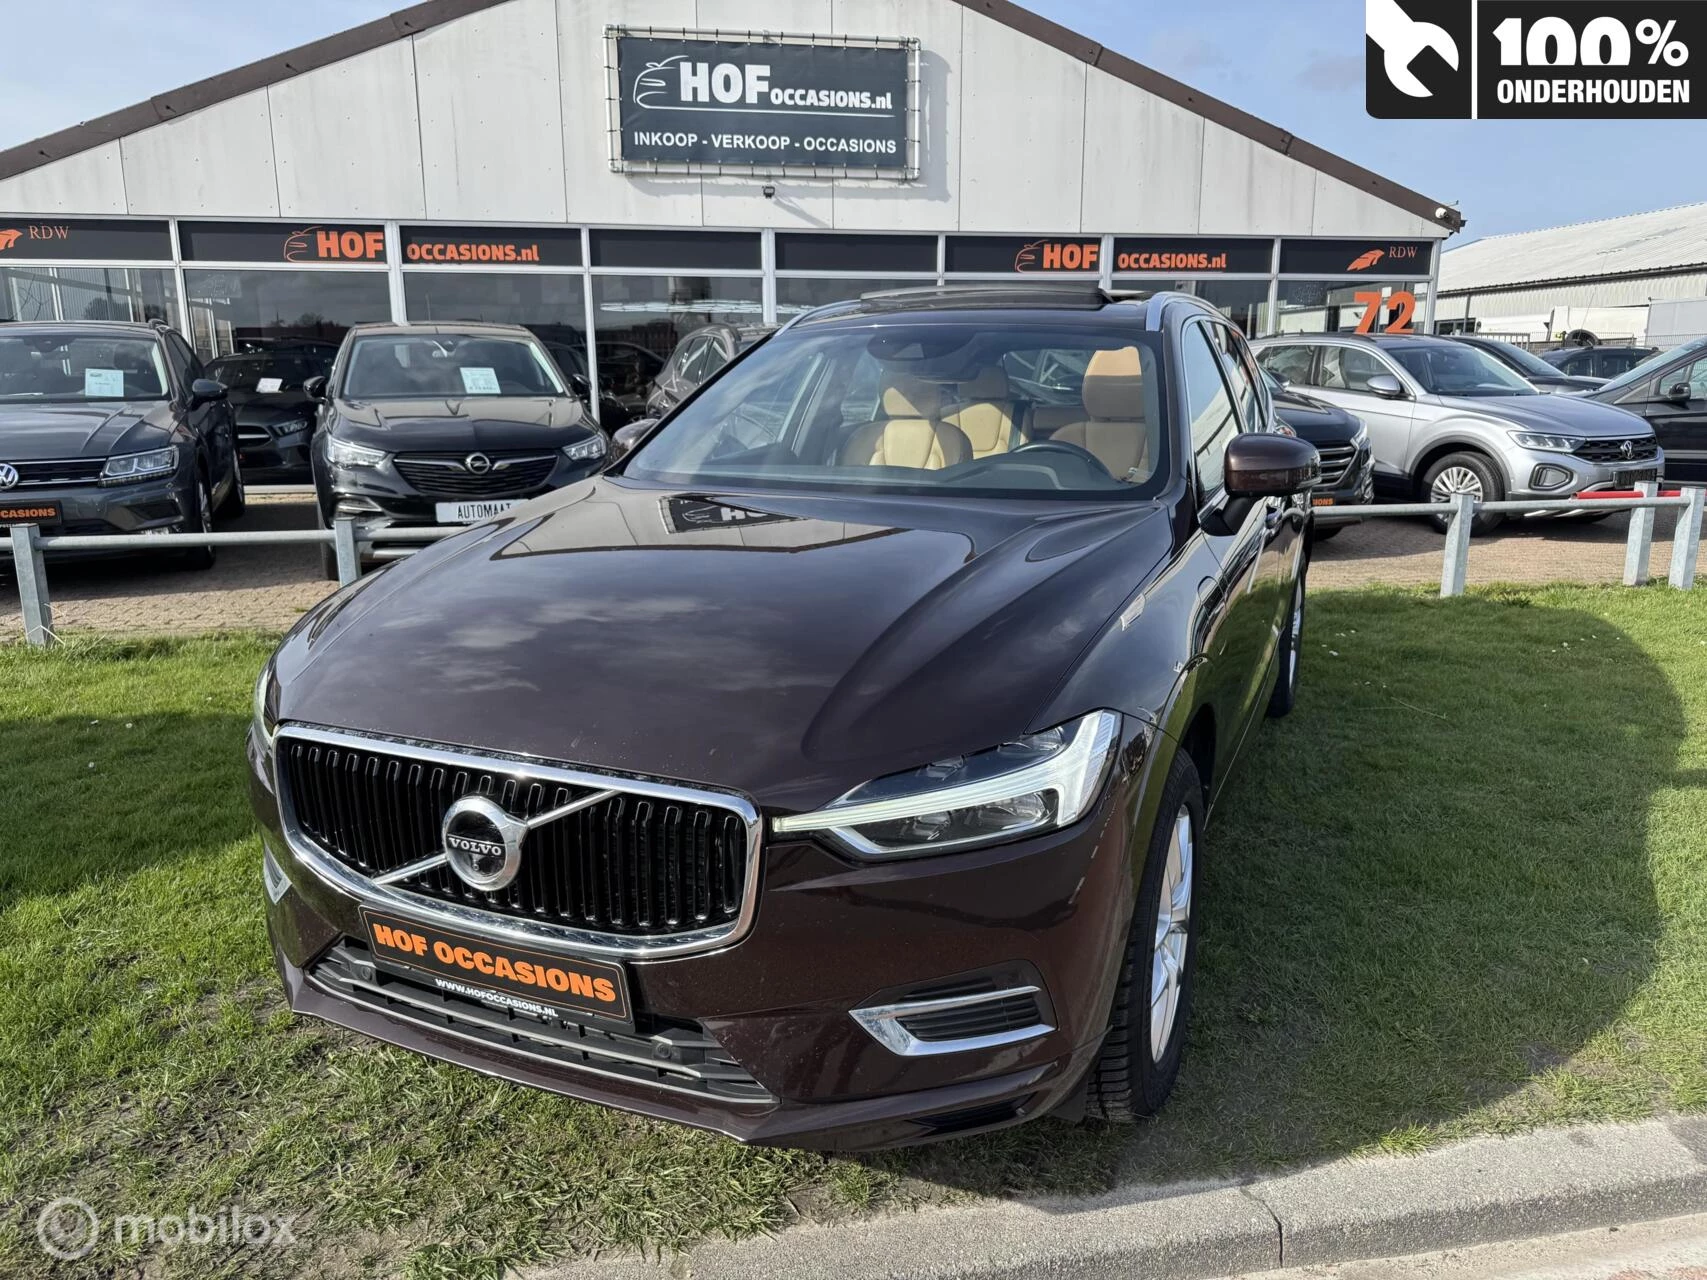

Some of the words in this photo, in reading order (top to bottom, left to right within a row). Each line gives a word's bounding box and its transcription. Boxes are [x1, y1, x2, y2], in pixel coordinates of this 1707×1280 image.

[679, 61, 770, 104] HOF
[770, 88, 892, 109] OCCASIONS.nl
[633, 131, 698, 147] INKOOP
[711, 134, 790, 150] VERKOOP
[803, 138, 897, 154] OCCASIONS
[29, 225, 69, 240] RDW
[316, 230, 384, 259] HOF
[407, 243, 540, 262] OCCASIONS.nl
[1042, 243, 1099, 270] HOF
[1117, 252, 1227, 269] OCCASIONS.nl
[1389, 246, 1418, 259] RDW
[1353, 290, 1416, 335] 72
[448, 837, 502, 856] VOLVO
[373, 923, 428, 956] HOF
[433, 941, 616, 1001] OCCASIONS
[435, 978, 559, 1017] WWW.HOFOCCASIONS.NL
